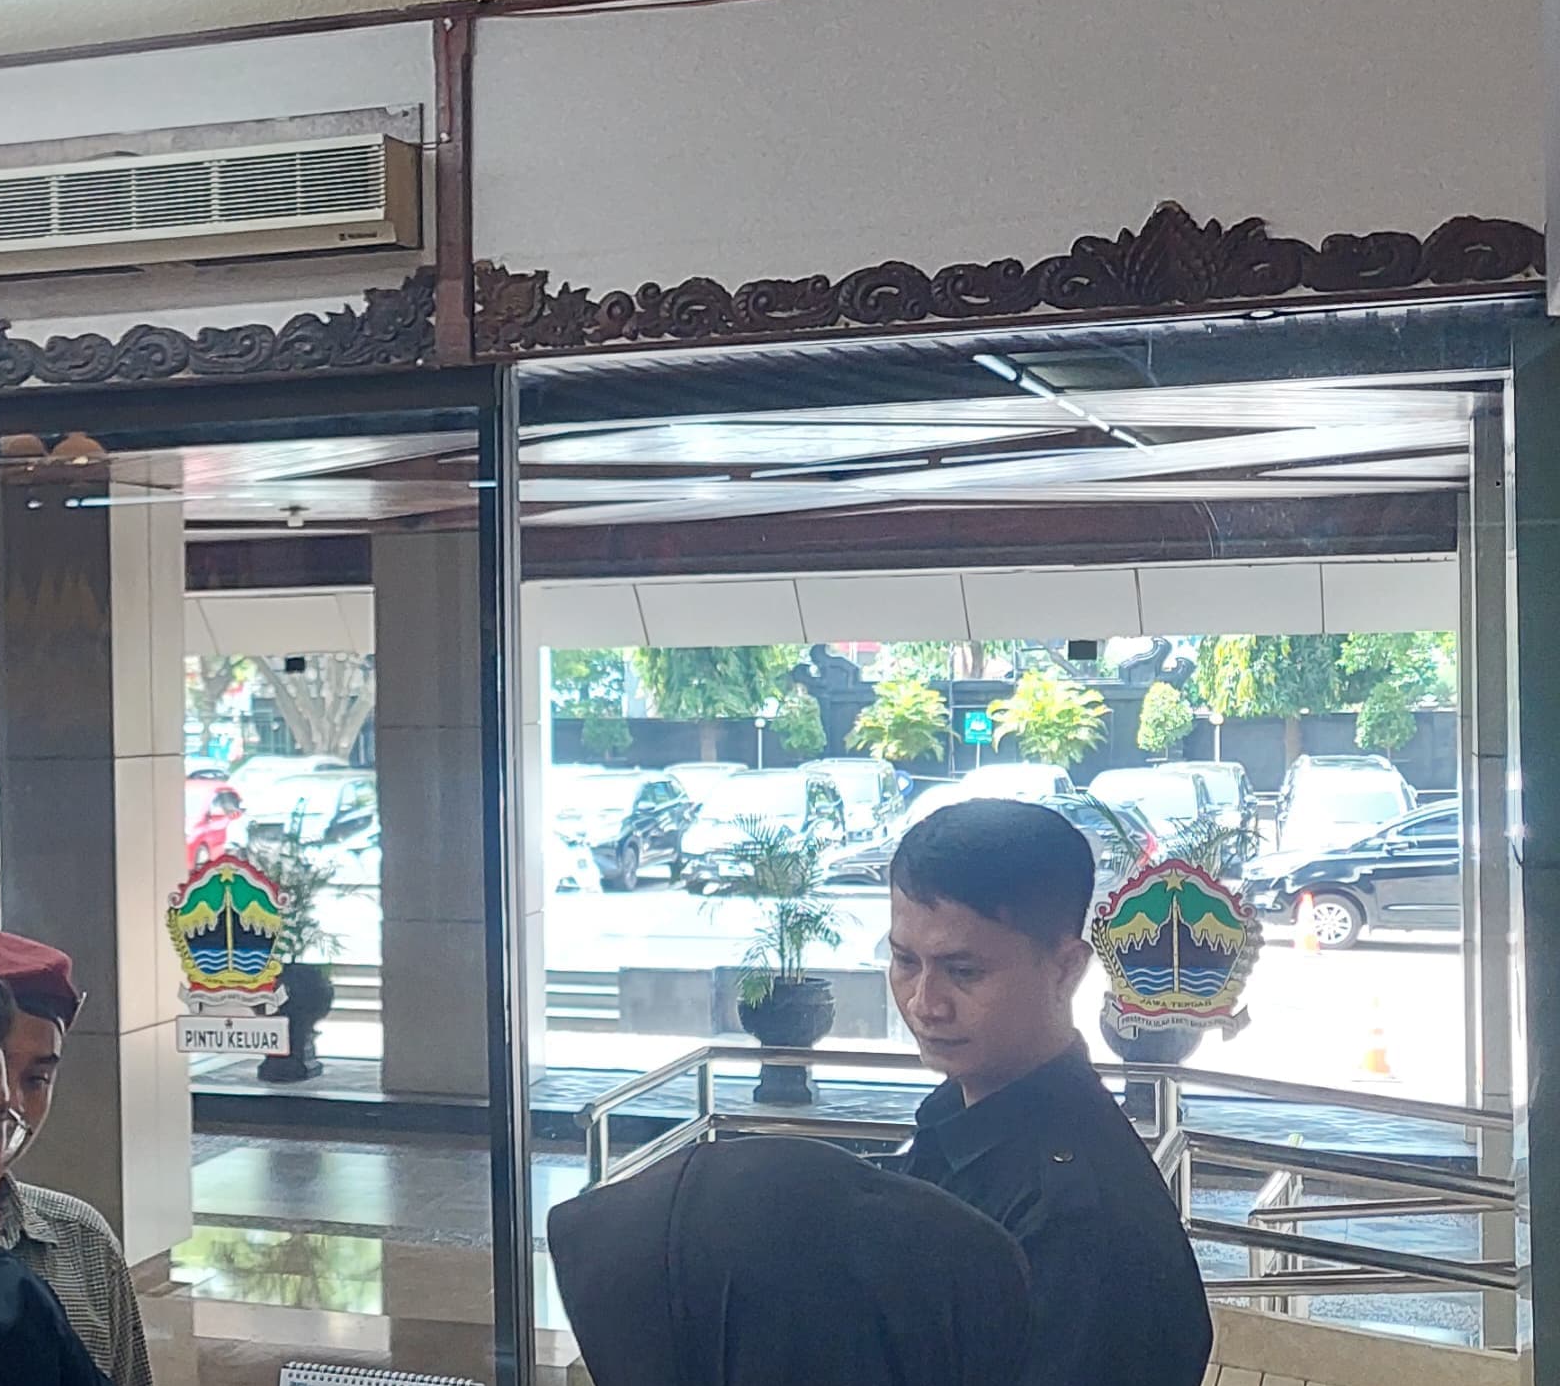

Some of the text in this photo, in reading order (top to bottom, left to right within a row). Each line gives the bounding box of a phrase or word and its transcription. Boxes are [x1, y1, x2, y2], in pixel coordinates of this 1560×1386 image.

[1140, 999, 1168, 1010] JAWA
[185, 1029, 279, 1050] PINTU KELUAR
